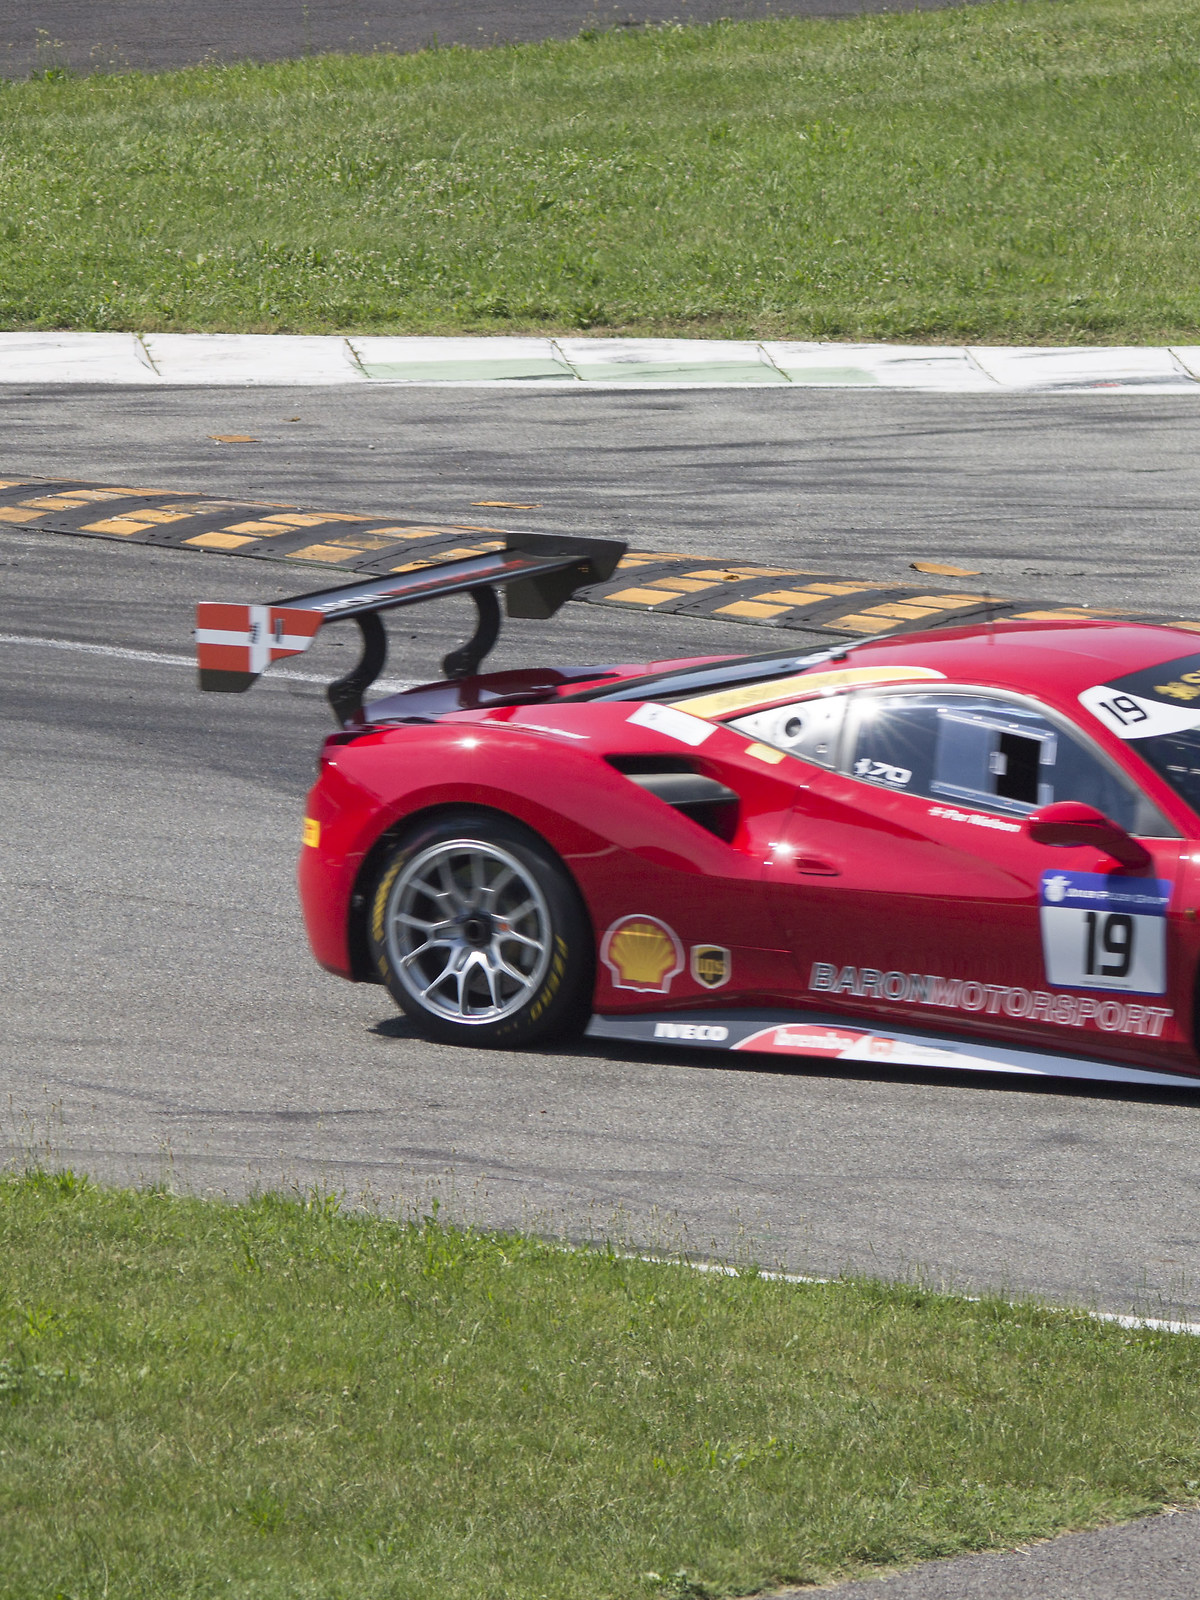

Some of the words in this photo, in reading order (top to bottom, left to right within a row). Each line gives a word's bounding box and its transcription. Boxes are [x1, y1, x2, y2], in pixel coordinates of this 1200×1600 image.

[1099, 695, 1148, 726] 19
[1084, 911, 1134, 978] 19
[653, 1022, 730, 1042] IVECO
